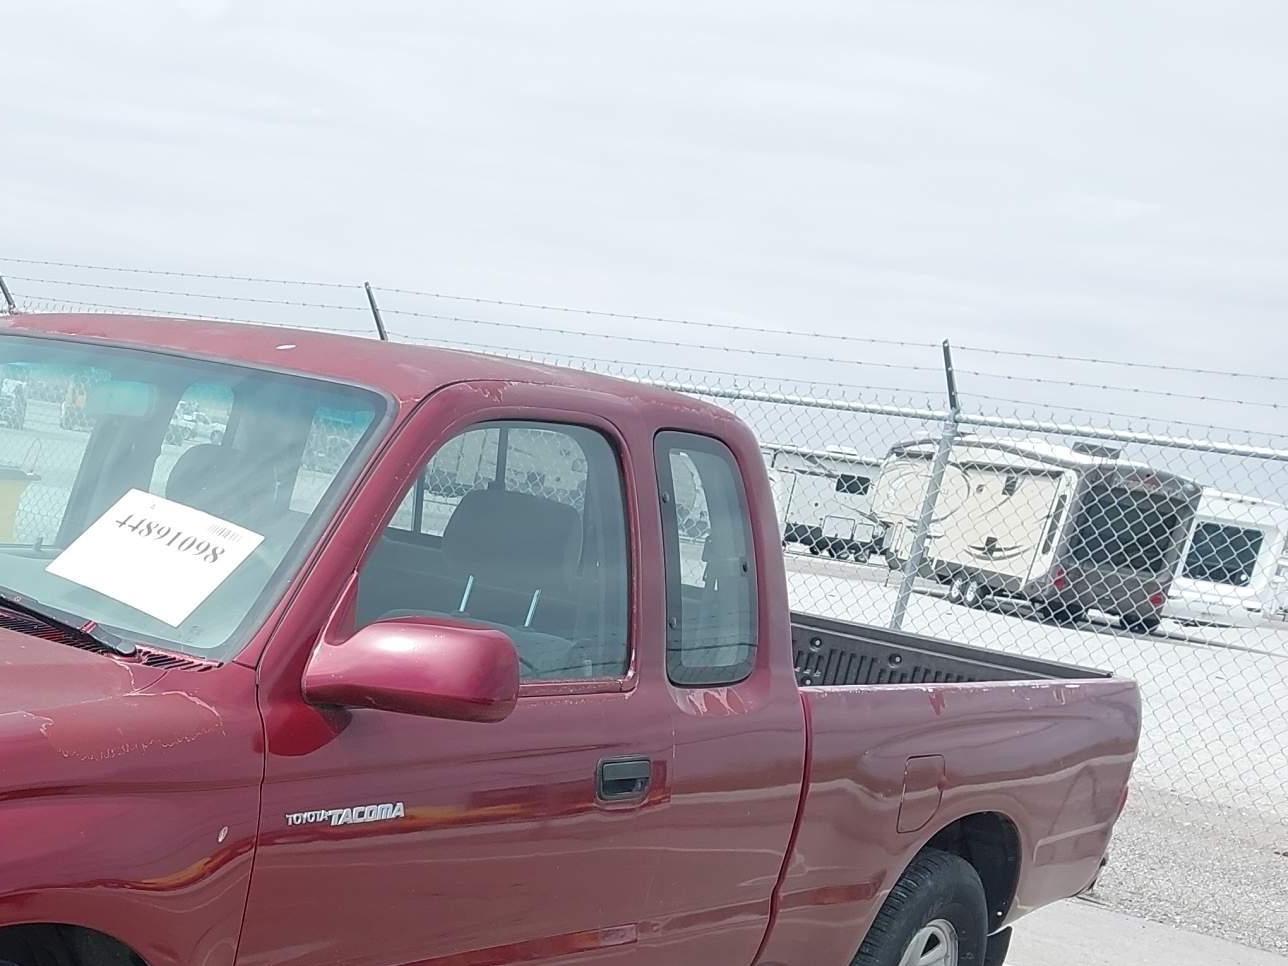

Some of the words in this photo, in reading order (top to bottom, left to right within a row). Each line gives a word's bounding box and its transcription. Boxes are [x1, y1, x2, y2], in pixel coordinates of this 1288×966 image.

[115, 514, 225, 563] 44891098
[286, 809, 329, 826] TOYOTA
[327, 802, 405, 826] TACOMA
